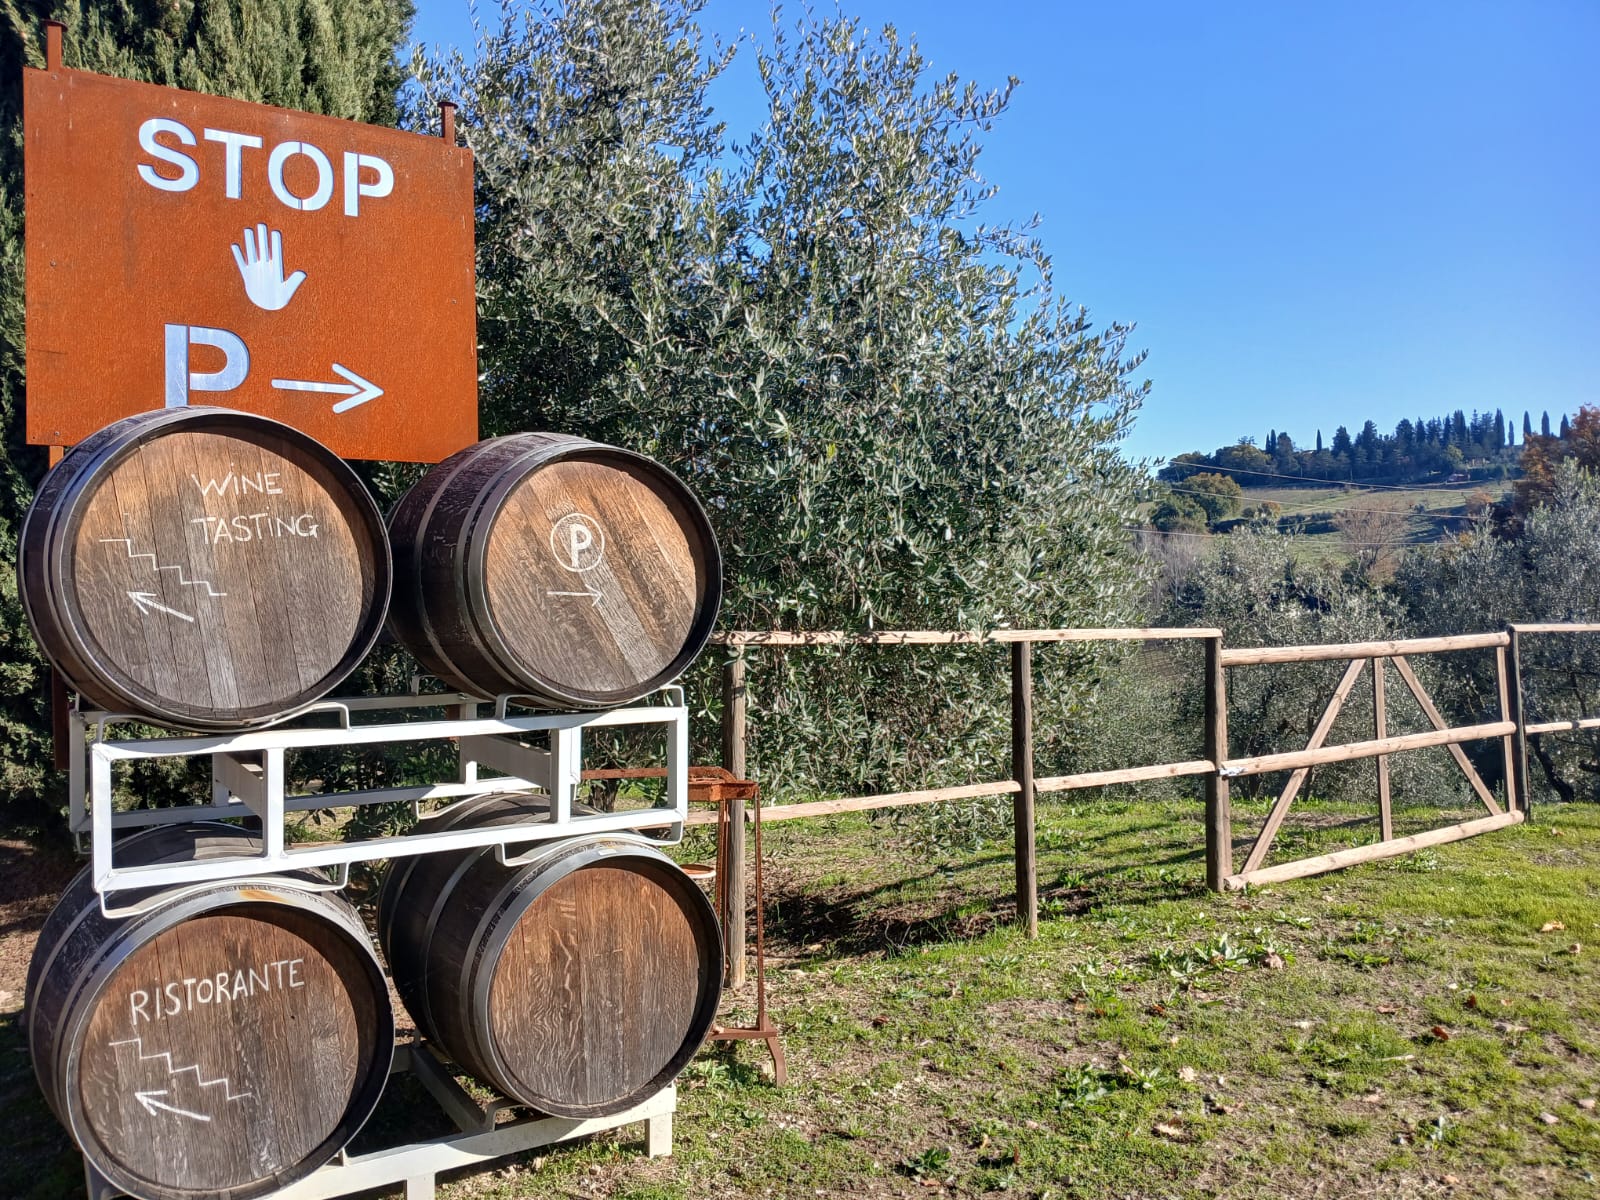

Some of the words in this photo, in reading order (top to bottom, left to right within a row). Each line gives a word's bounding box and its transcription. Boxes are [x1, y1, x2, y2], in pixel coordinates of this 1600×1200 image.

[137, 117, 395, 217] STOP
[164, 322, 250, 408] P
[570, 523, 592, 567] P
